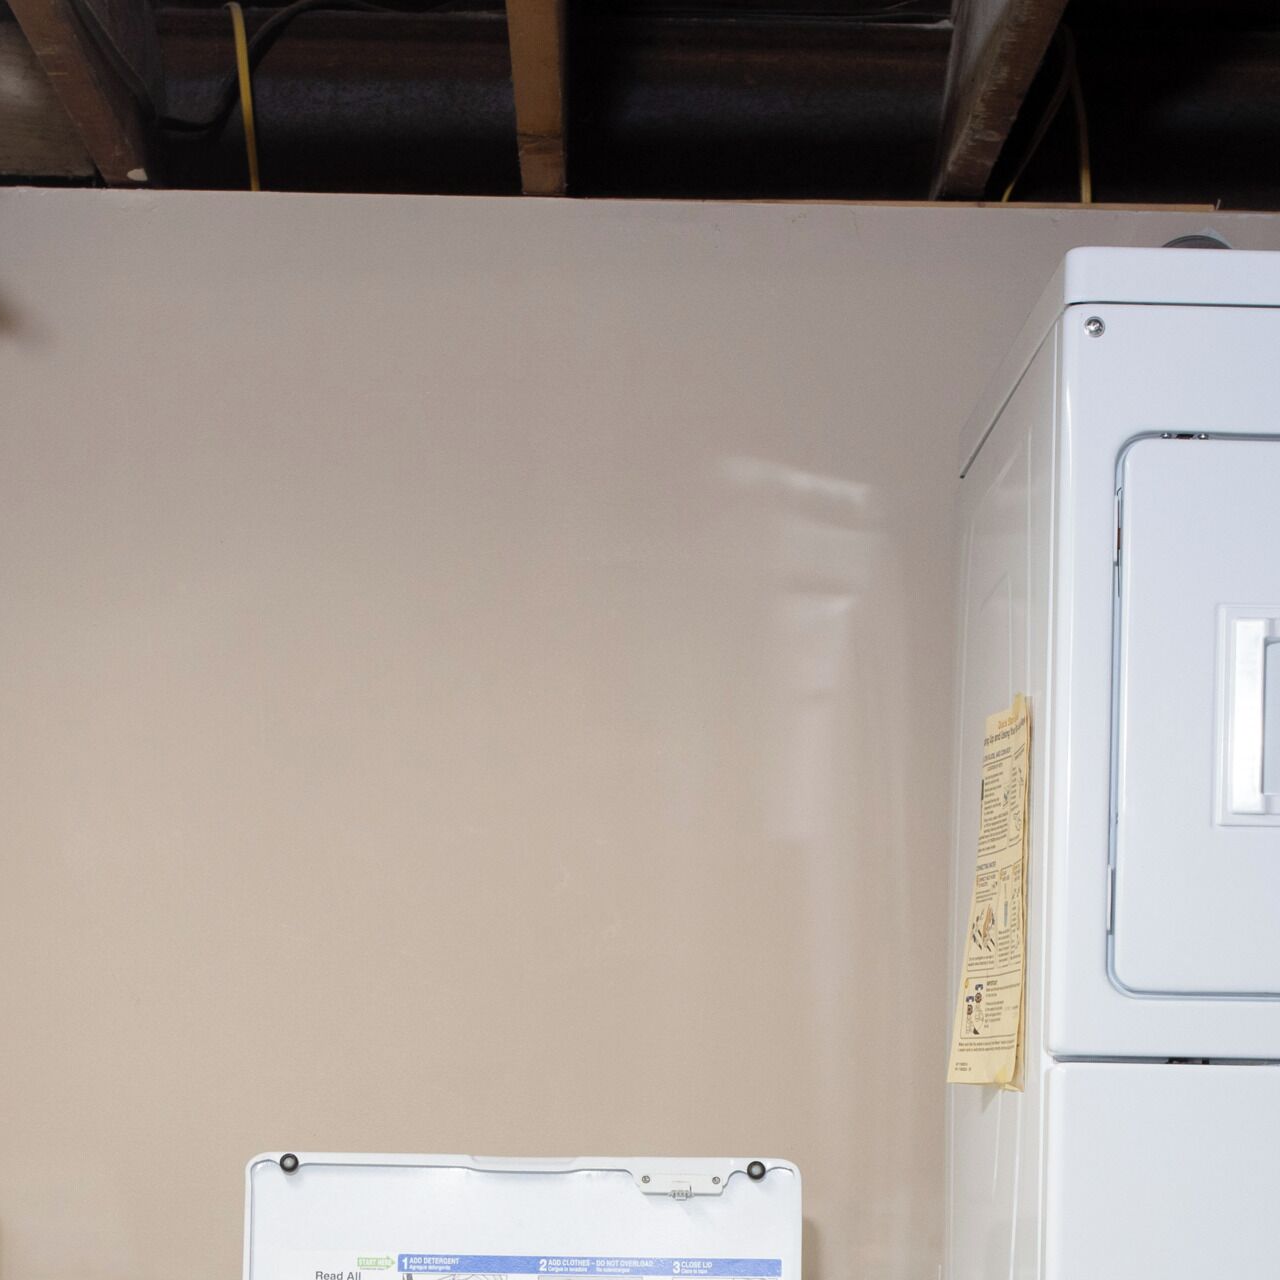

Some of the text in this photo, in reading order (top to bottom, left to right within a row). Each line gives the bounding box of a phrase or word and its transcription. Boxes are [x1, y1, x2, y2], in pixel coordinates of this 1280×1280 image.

[402, 1258, 408, 1270] 1
[409, 1257, 423, 1265] ADD
[539, 1258, 547, 1271] 2
[547, 1259, 562, 1267] ADD
[562, 1259, 591, 1267] CLOTHES
[620, 1260, 654, 1268] OVERLOAD
[673, 1261, 681, 1274] 3
[315, 1270, 362, 1280] Read All
